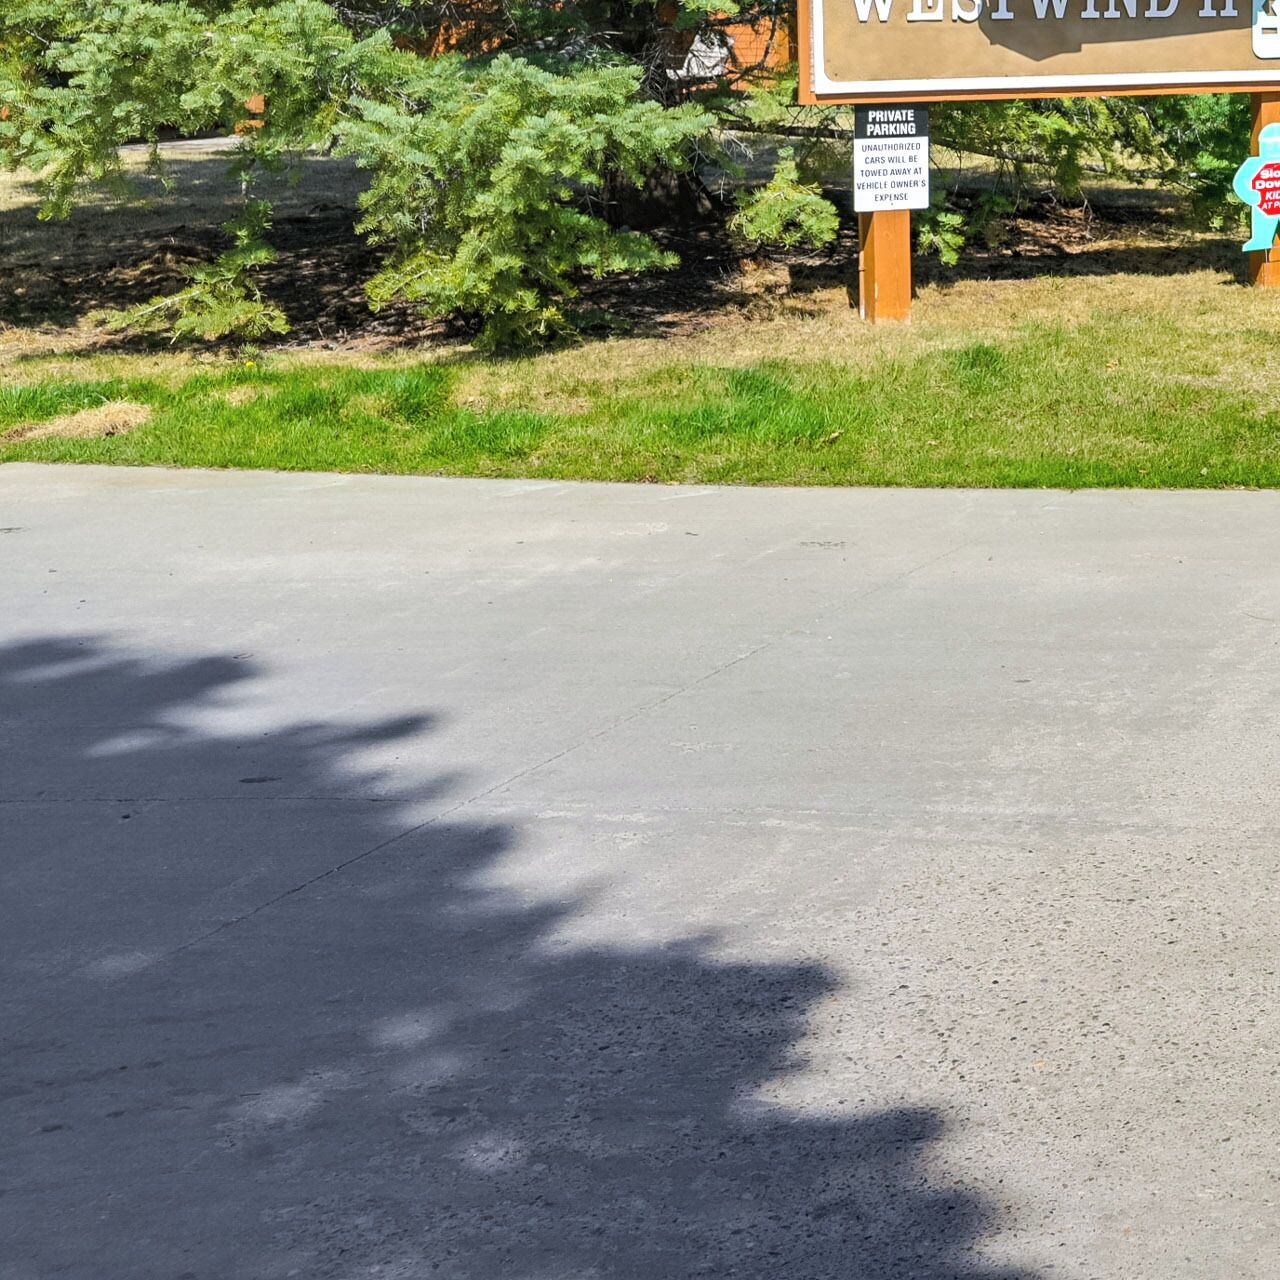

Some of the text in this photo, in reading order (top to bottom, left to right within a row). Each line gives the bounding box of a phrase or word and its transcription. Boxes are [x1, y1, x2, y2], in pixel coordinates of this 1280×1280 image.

[868, 109, 915, 122] PRIVATE
[866, 123, 917, 136] PARKING
[861, 142, 921, 152] UNAUTHORIZED
[864, 154, 918, 165] CARS WILL BE
[860, 167, 922, 177] TOWED AWAY AT
[856, 179, 926, 190] VEHICLE OWNER'S
[874, 193, 908, 202] EXPENSE
[1261, 201, 1273, 209] AT
